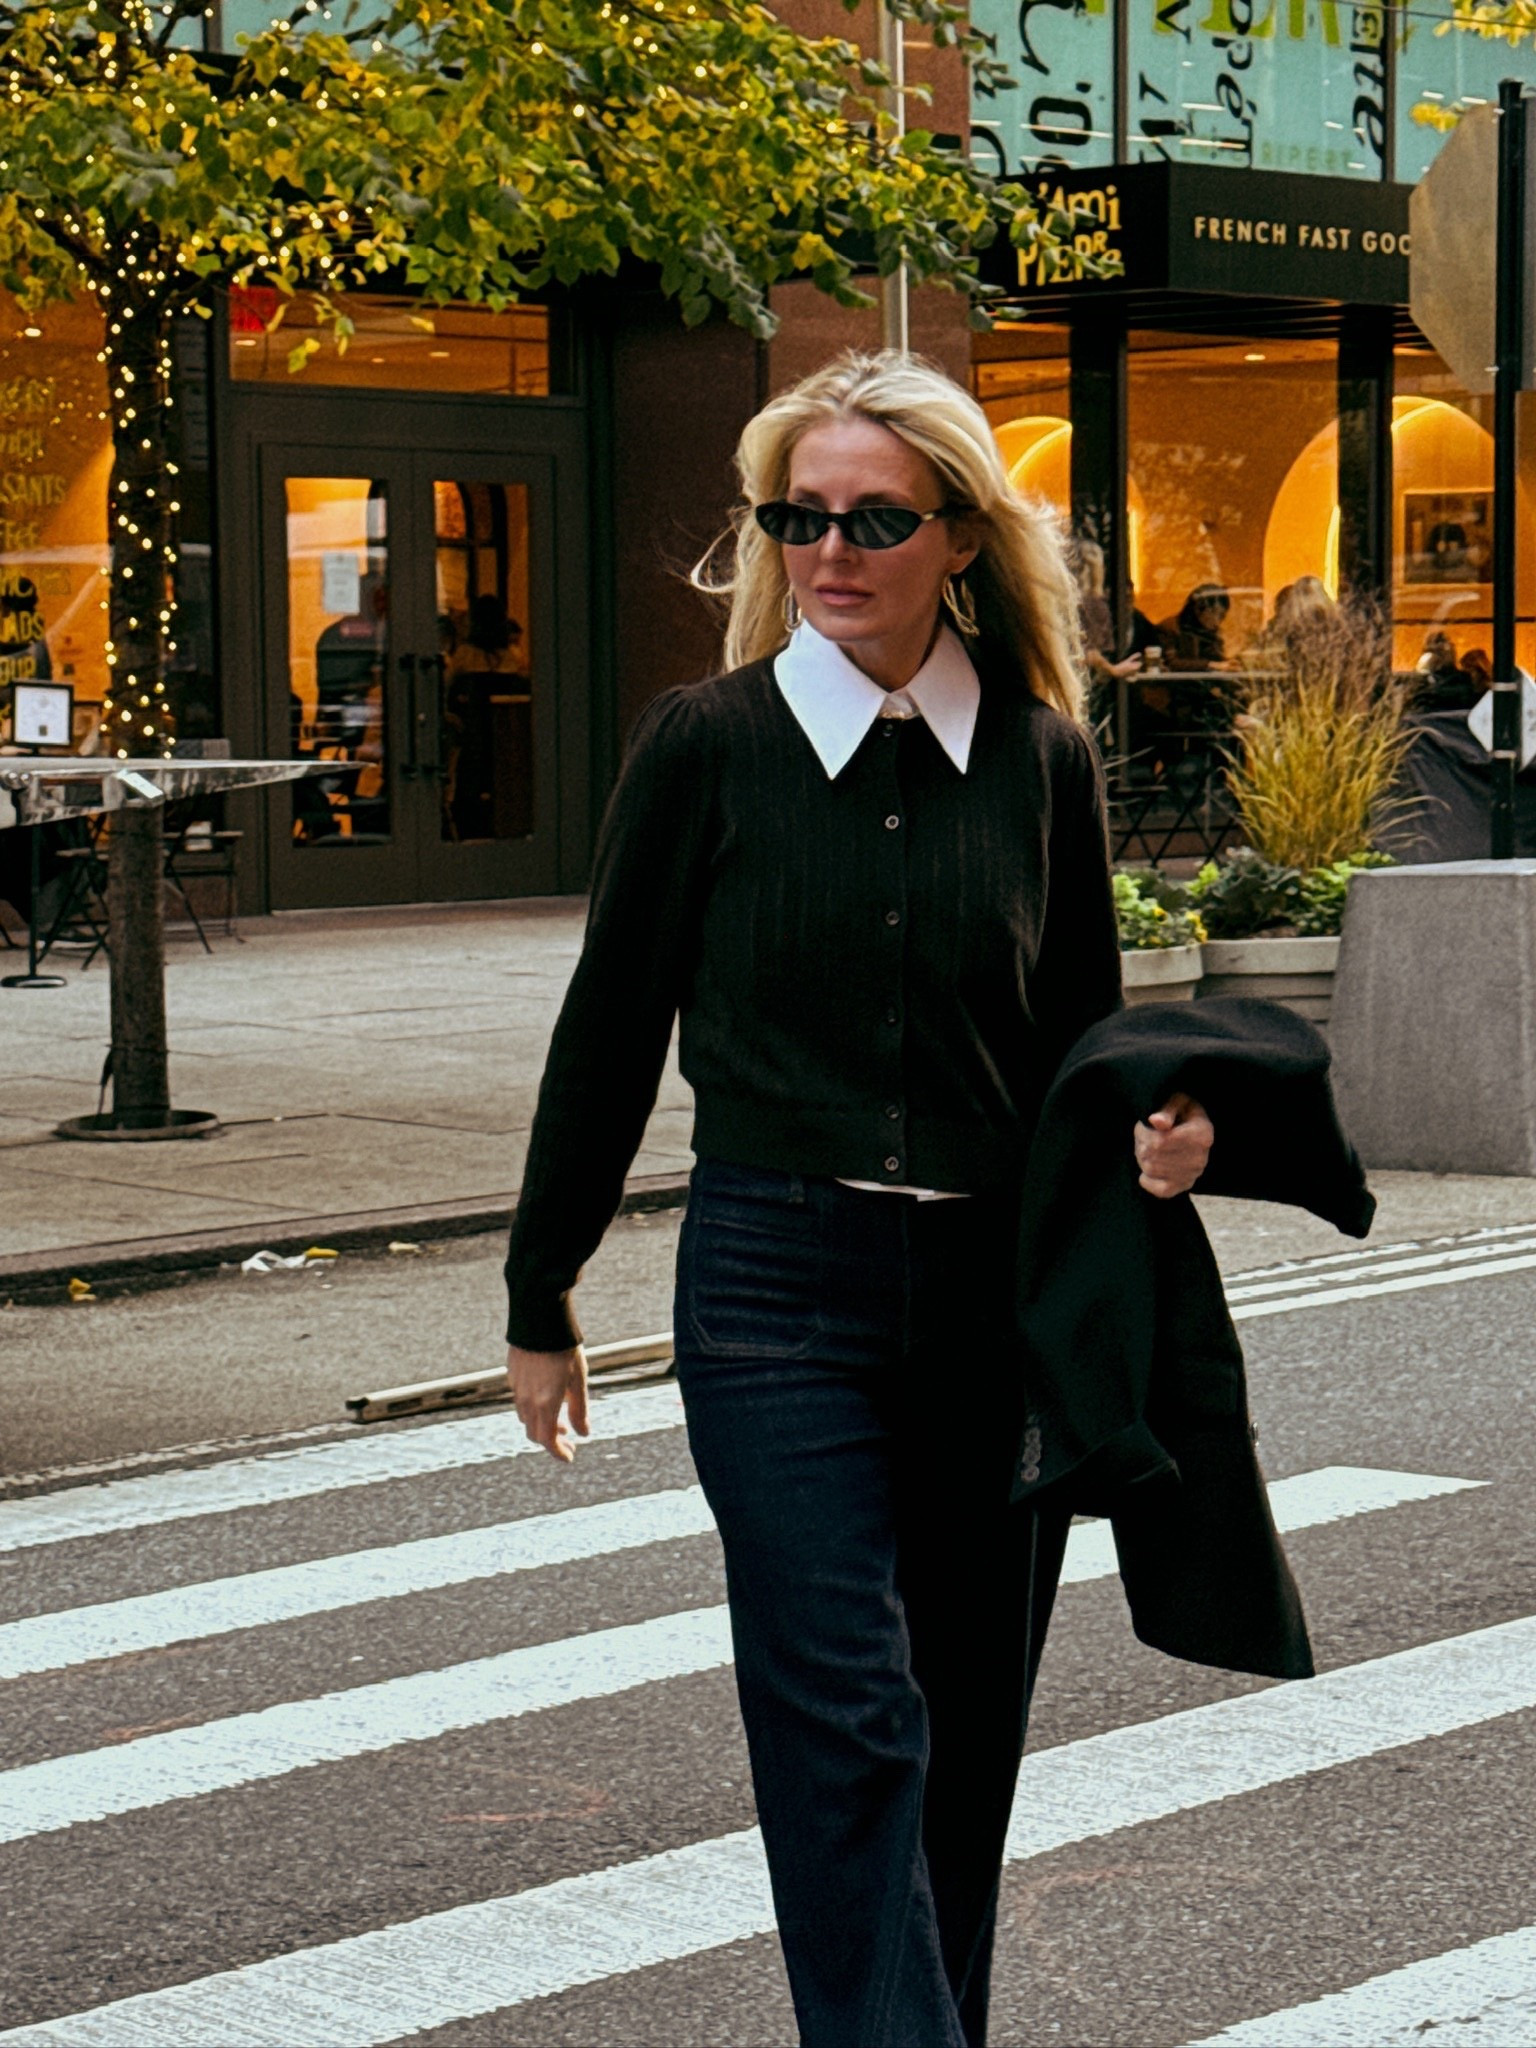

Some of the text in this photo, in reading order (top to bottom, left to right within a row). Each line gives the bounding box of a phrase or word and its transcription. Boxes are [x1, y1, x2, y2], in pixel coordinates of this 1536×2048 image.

[1036, 182, 1121, 232] 'Ami
[1194, 216, 1287, 245] FRENCH
[1298, 225, 1351, 251] FAST
[0, 473, 66, 506] SANTS
